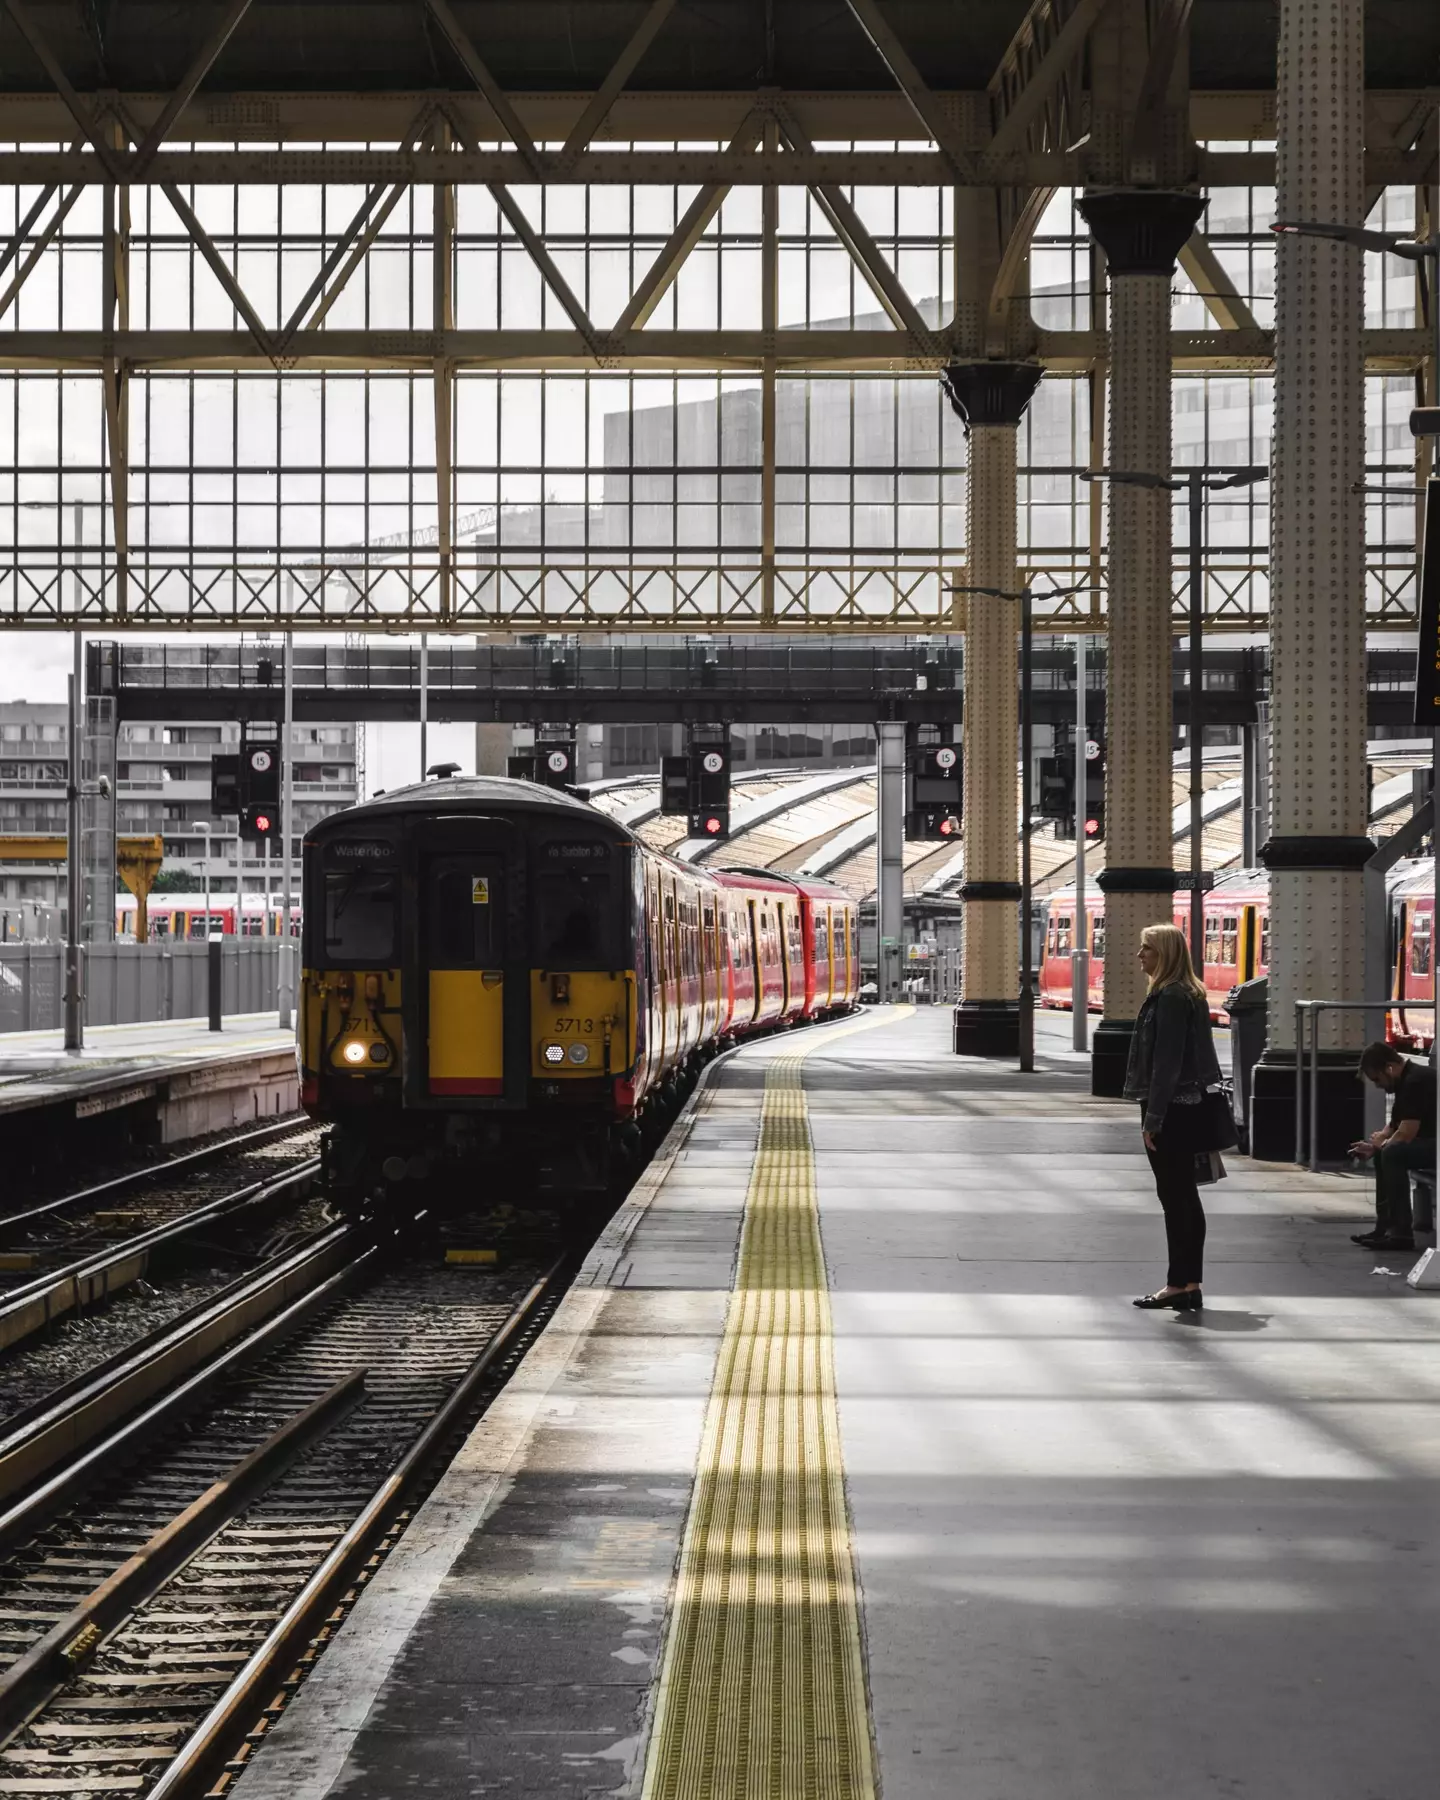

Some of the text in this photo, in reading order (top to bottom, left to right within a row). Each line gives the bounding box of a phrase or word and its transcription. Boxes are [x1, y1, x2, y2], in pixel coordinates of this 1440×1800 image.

[1086, 745, 1096, 755] 15
[257, 757, 265, 766] 15
[553, 757, 563, 767] 15
[709, 758, 718, 767] 15
[941, 753, 951, 763] 15
[334, 844, 391, 857] Waterloo
[1178, 878, 1196, 889] 005
[554, 1018, 594, 1034] 5713
